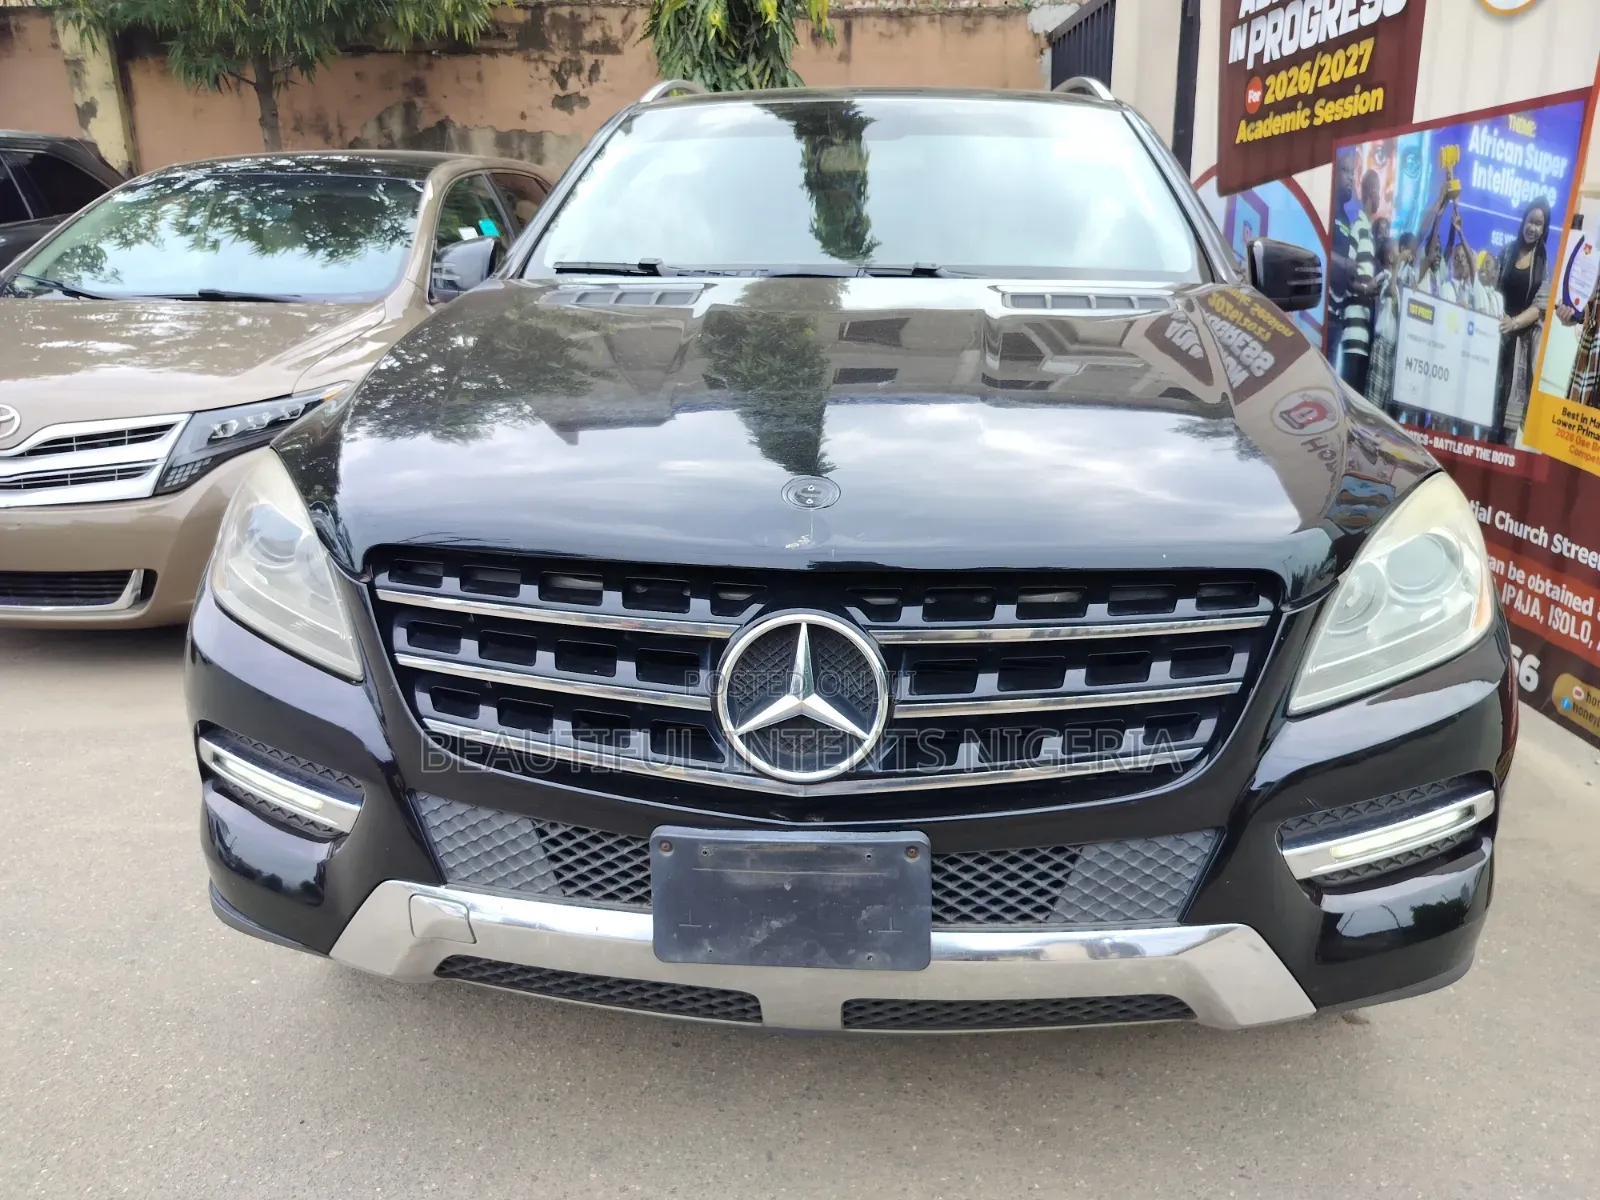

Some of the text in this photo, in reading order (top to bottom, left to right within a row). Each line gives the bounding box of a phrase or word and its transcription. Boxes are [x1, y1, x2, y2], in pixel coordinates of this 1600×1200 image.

[1228, 23, 1248, 64] IN
[1247, 37, 1375, 105] For 2026/2027
[1235, 84, 1384, 144] Academic Session
[1468, 125, 1568, 182] African Super
[1472, 160, 1557, 208] Intelligence
[1552, 414, 1576, 431] Lower
[1562, 407, 1579, 421] Best
[1581, 413, 1588, 424] in
[1433, 436, 1464, 454] BATTLE
[1464, 443, 1475, 457] OF
[1475, 446, 1491, 463] THE
[1491, 451, 1516, 468] BOTS
[1495, 510, 1549, 548] Church
[1508, 561, 1526, 585] be
[1528, 574, 1594, 617] obtained
[1502, 582, 1594, 649] IPAJA, ISOLO,
